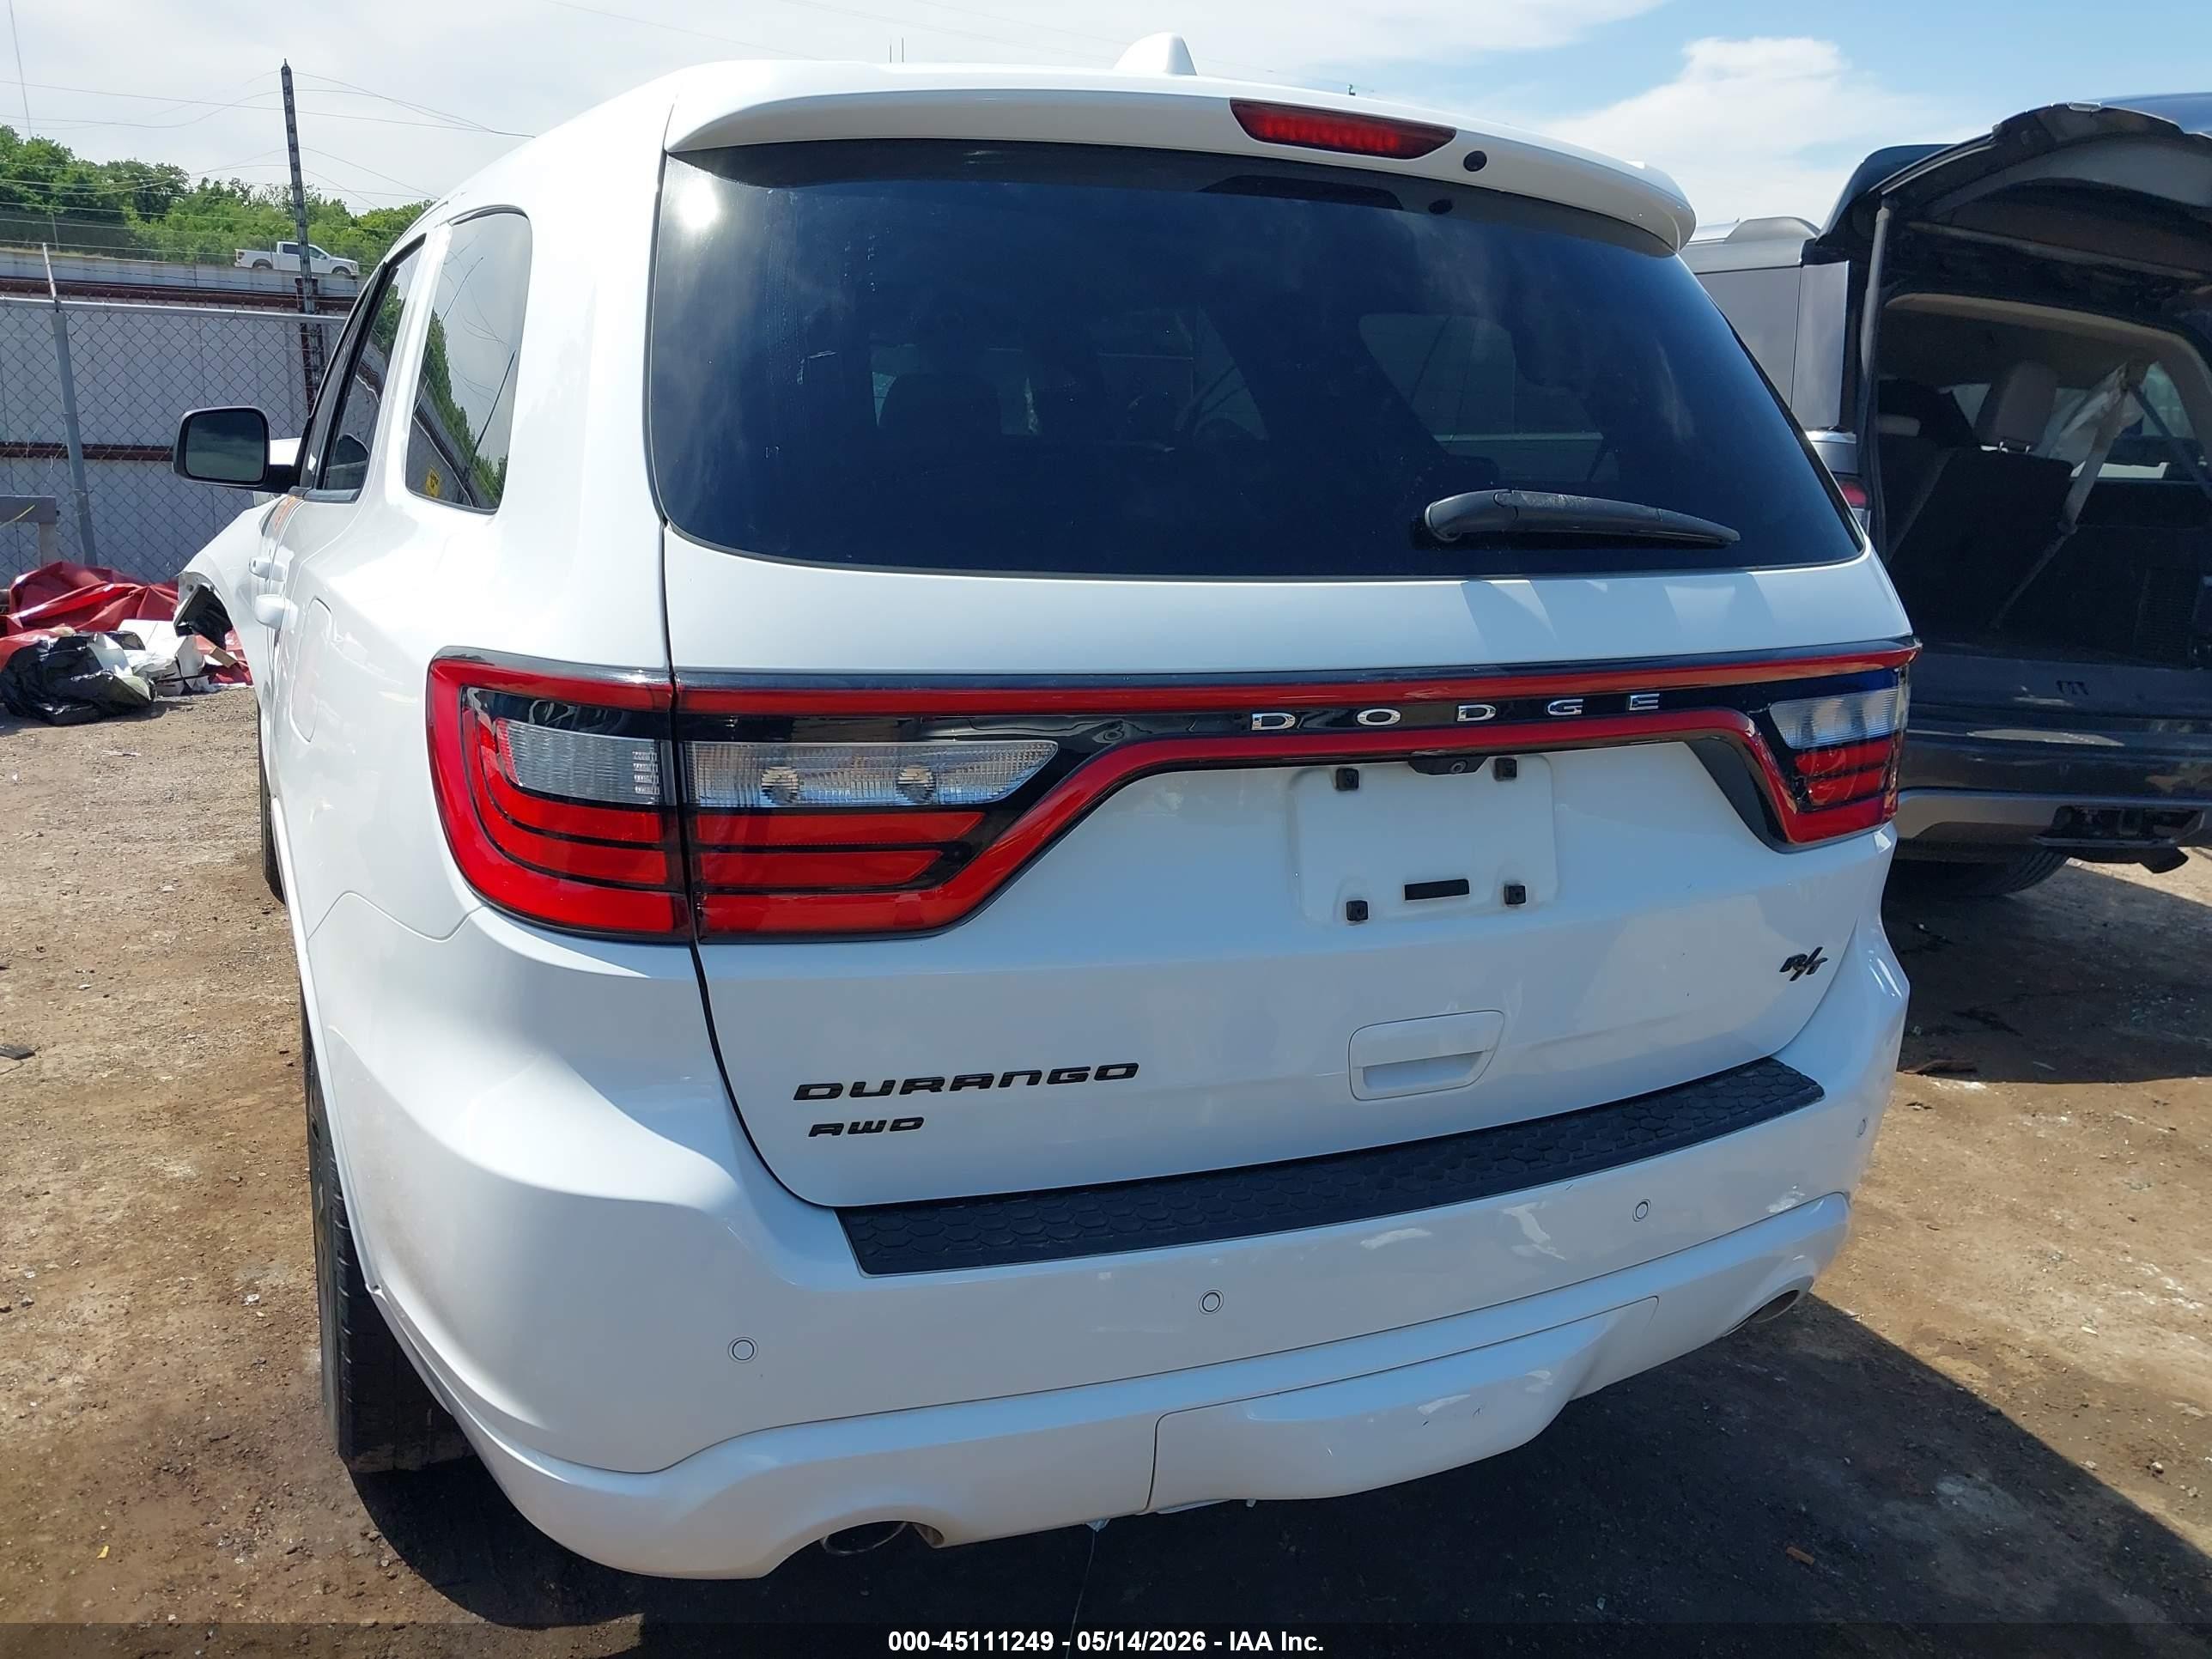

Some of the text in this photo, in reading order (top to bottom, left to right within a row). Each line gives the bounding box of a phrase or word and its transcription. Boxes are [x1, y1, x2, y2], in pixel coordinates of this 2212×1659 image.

[1251, 693, 1661, 731] DODGE
[1778, 946, 1828, 981] R/T
[793, 1062, 1139, 1101] DURANGO
[808, 1116, 925, 1138] AWD
